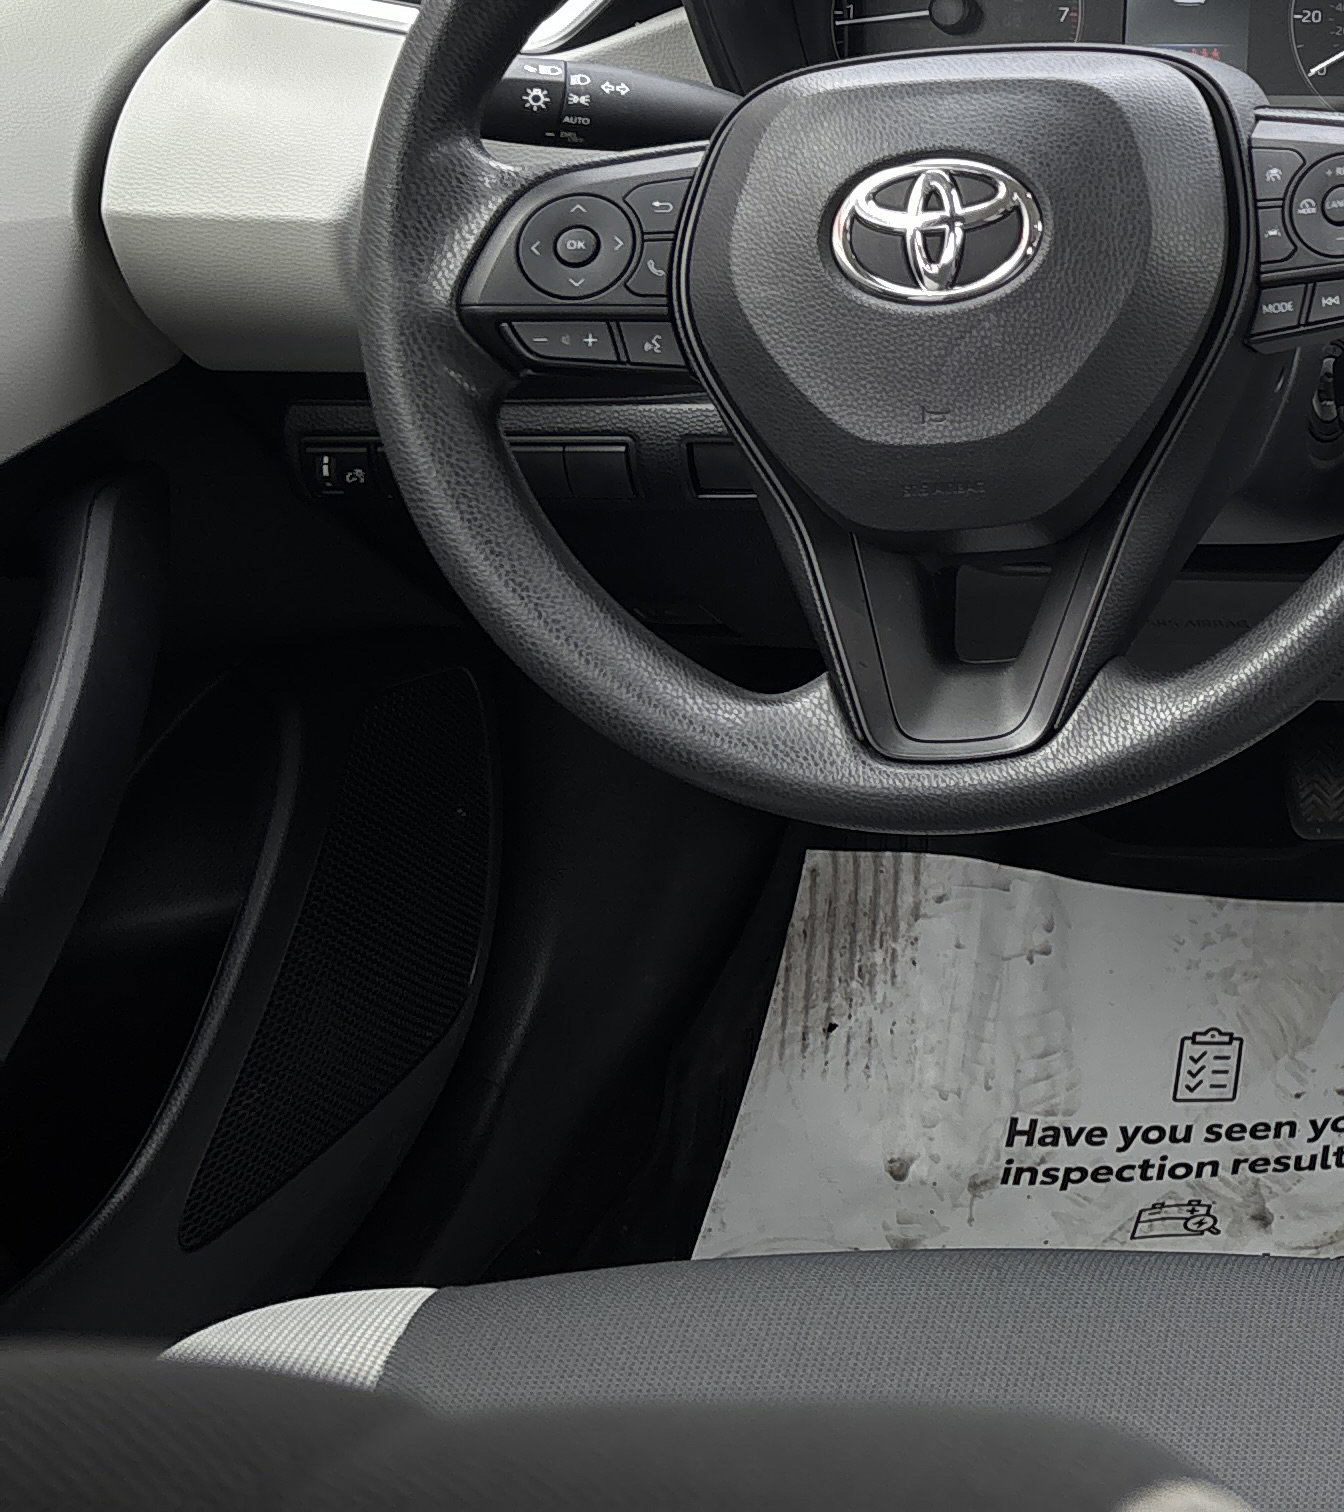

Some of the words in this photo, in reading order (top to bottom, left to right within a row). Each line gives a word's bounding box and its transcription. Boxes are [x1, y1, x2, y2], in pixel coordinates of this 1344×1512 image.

[845, 3, 854, 18] 1
[1058, 6, 1070, 23] 7
[1301, 10, 1322, 23] 20
[563, 116, 591, 125] AUTO
[566, 239, 586, 250] OK
[1262, 300, 1294, 314] MODE
[1005, 1117, 1108, 1149] Have
[1115, 1121, 1193, 1154] you
[1203, 1115, 1297, 1144] seen
[1000, 1155, 1220, 1192] inspection
